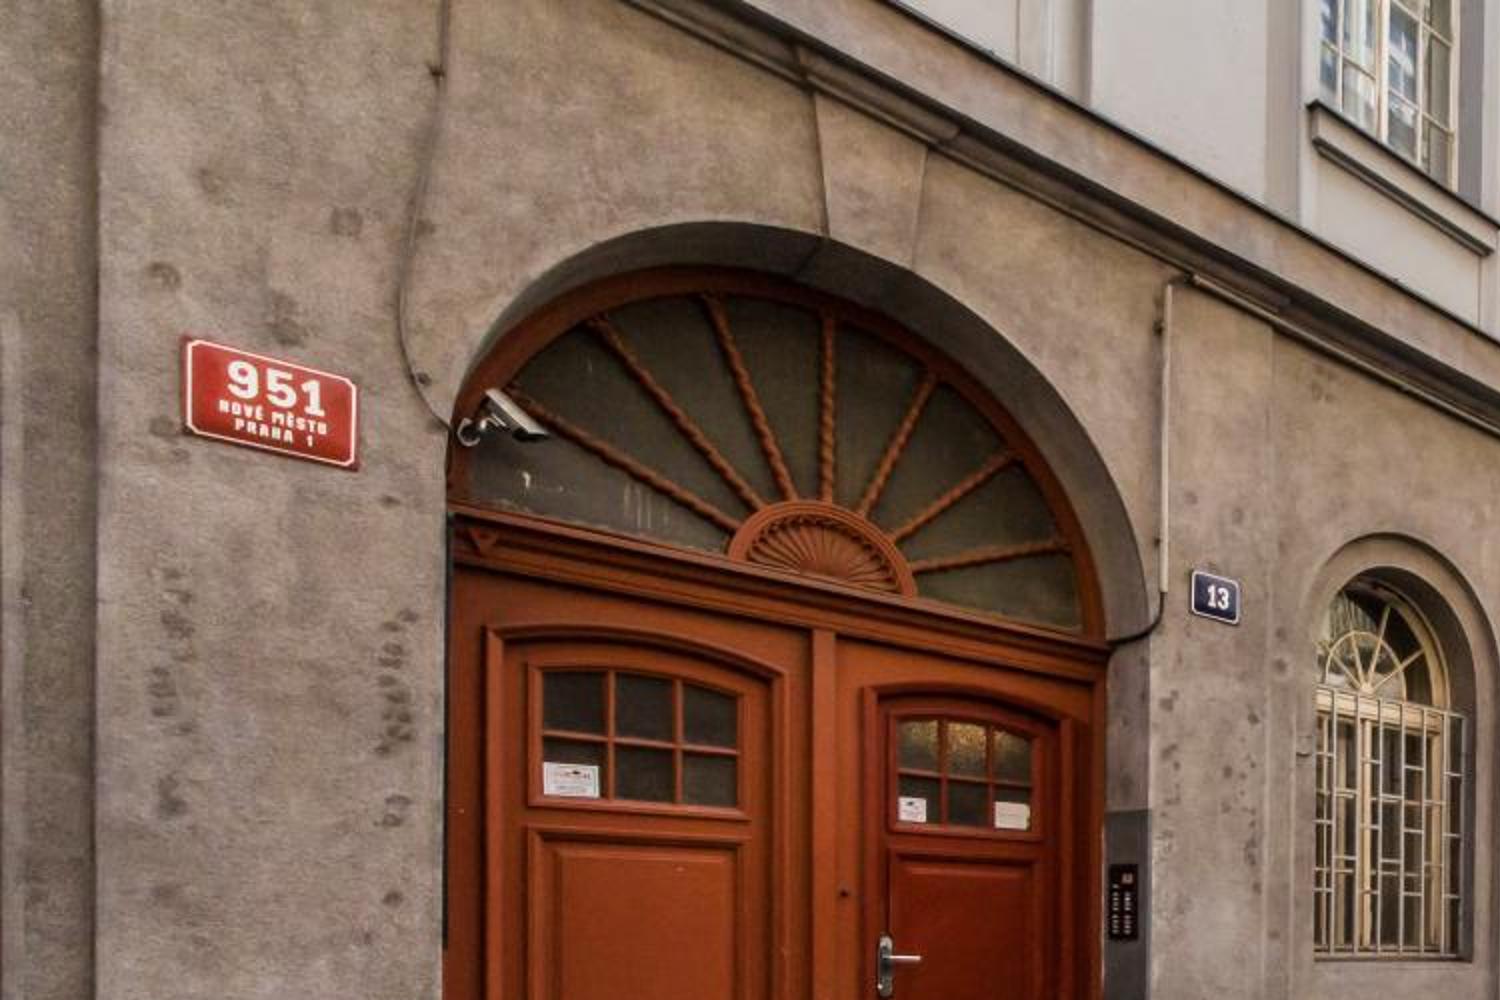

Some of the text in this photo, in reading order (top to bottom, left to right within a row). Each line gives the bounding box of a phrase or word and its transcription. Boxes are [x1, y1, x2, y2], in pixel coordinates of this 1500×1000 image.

[227, 360, 326, 417] 951
[218, 399, 328, 435] NOVÉ MĚSTO
[234, 418, 314, 448] PRAHA 1
[1207, 584, 1229, 611] 13
